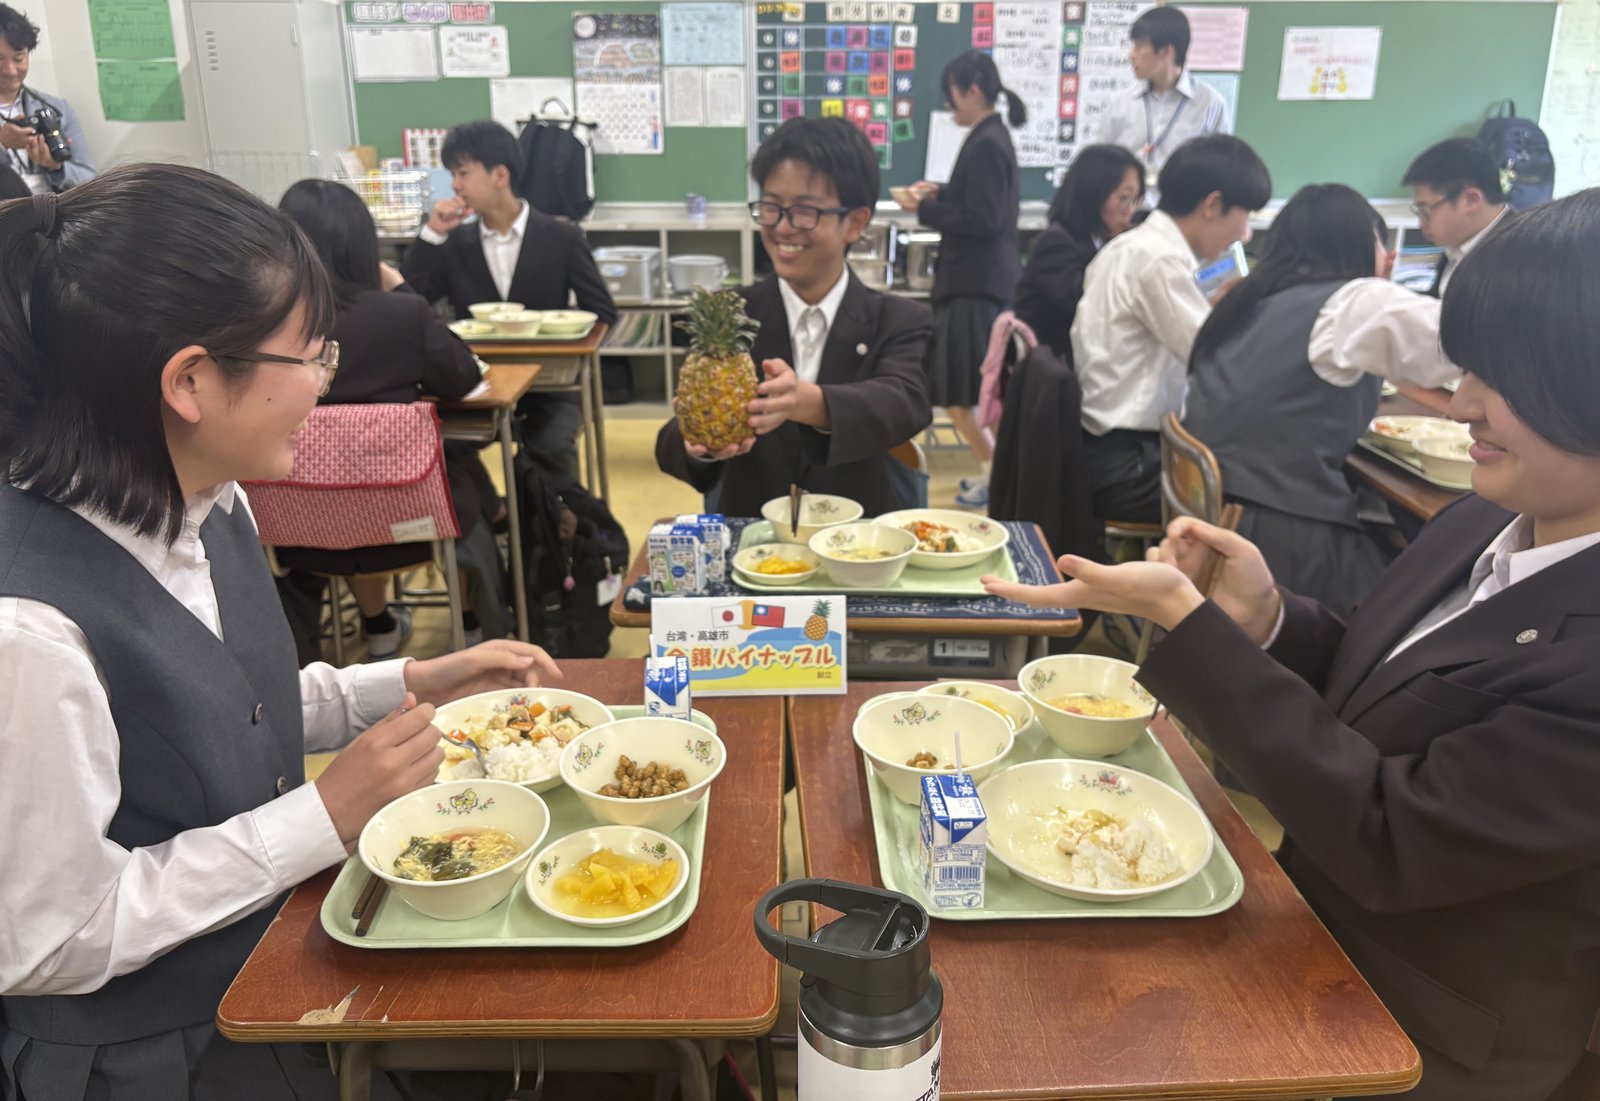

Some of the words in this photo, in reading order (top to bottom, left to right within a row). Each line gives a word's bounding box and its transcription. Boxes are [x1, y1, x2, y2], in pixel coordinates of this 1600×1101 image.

[666, 630, 730, 642] 台湾・高雄市
